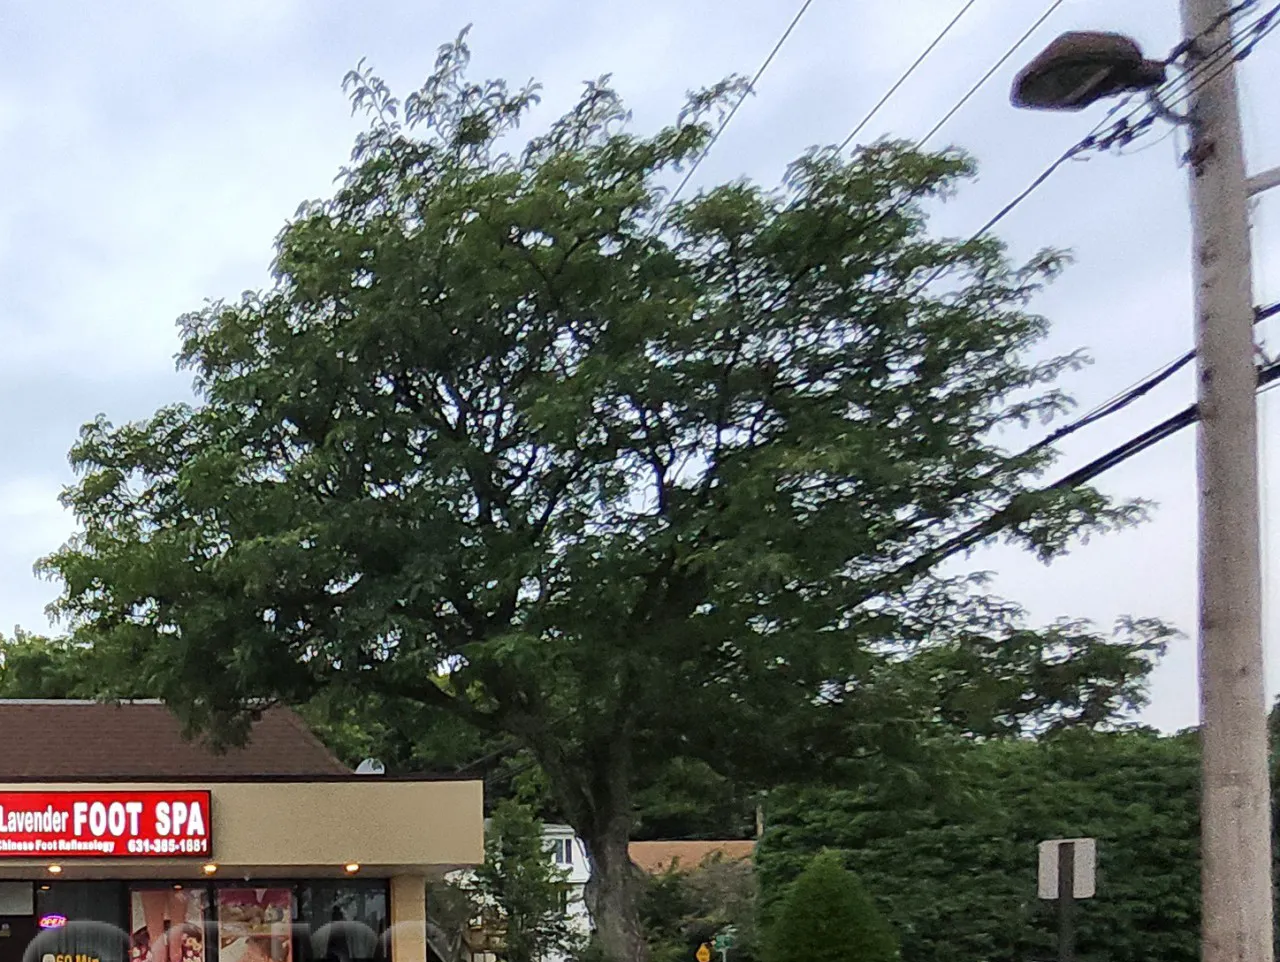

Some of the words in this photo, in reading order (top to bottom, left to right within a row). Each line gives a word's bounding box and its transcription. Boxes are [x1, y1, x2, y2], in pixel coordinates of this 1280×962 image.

[73, 801, 143, 836] FOOT
[155, 801, 206, 836] SPA
[35, 839, 57, 851] Foot
[58, 839, 115, 853] Reflexology
